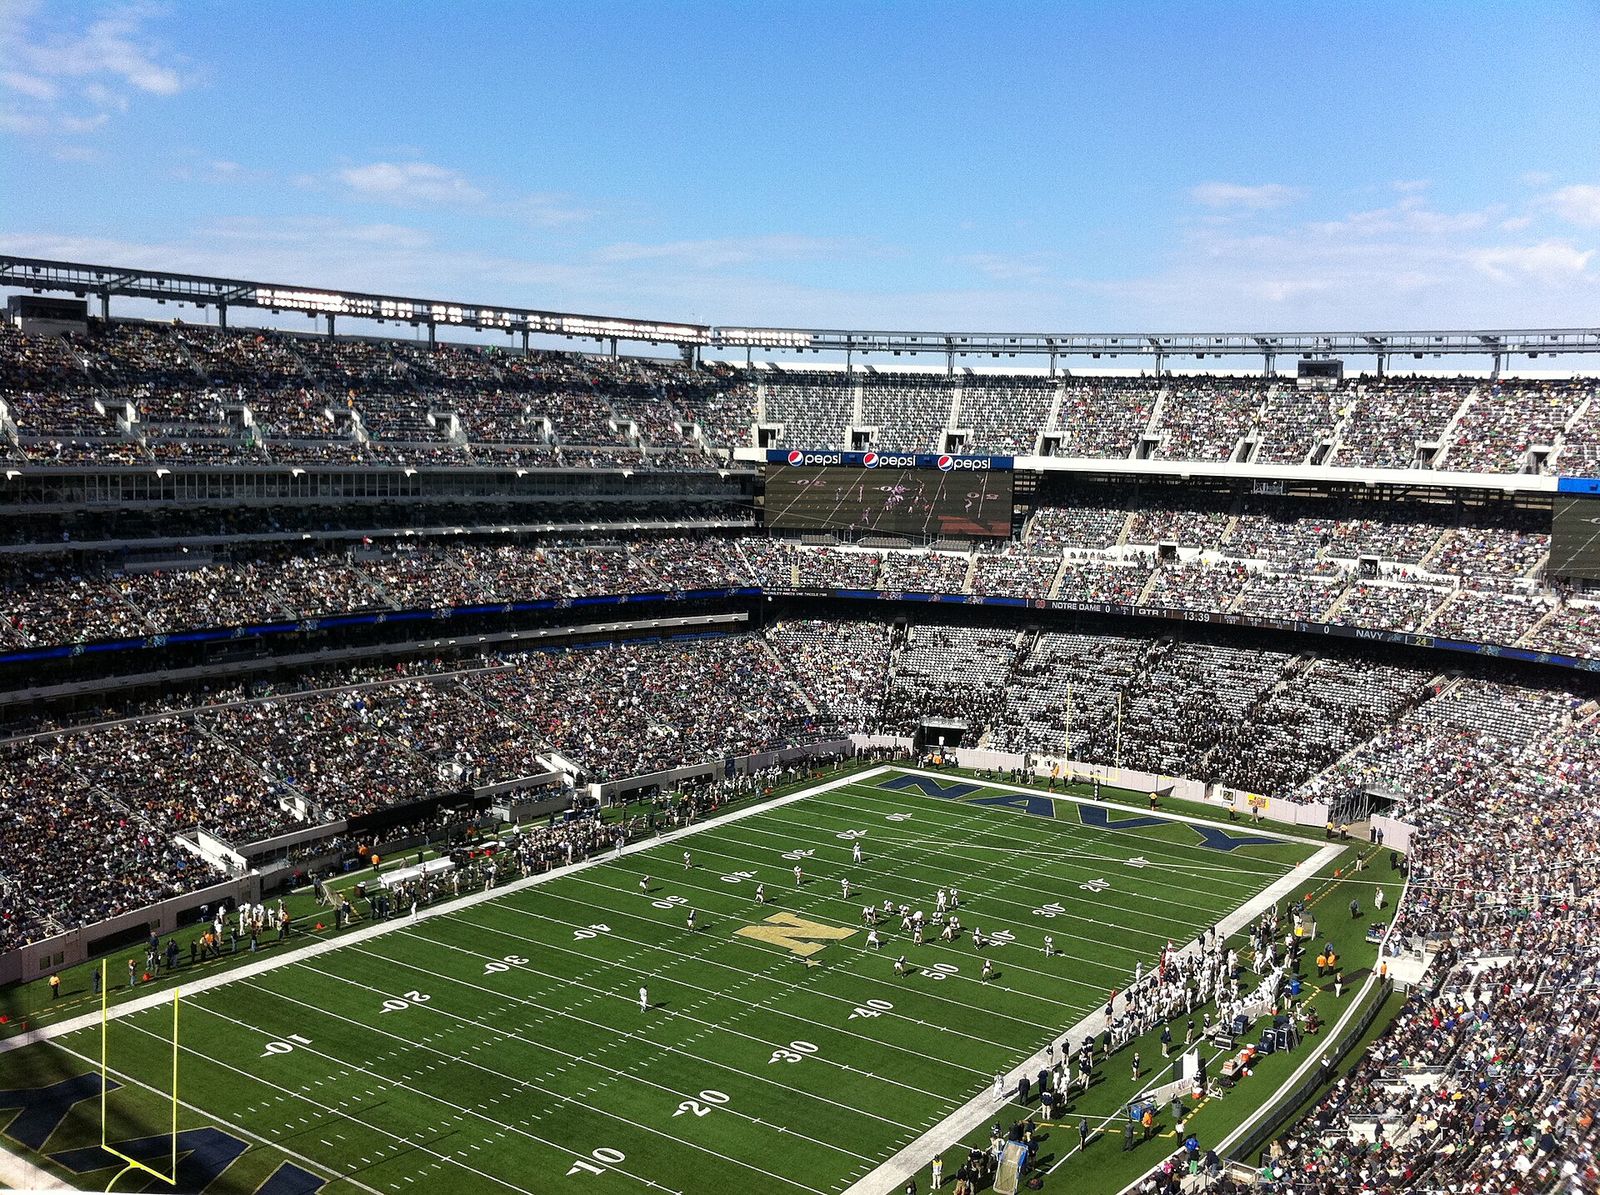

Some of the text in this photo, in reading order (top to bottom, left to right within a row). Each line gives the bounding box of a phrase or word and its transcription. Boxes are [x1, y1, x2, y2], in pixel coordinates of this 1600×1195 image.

[805, 453, 841, 466] pepsi
[879, 455, 916, 468] pepsi
[954, 457, 991, 471] pepsi
[1052, 602, 1077, 610] NOTRE
[1079, 604, 1101, 612] DAME
[1105, 605, 1111, 613] 0
[1139, 608, 1159, 616] QTR
[1183, 611, 1210, 622] 13:39
[1324, 625, 1384, 640] 0 NAVY
[1415, 637, 1427, 646] 24
[876, 774, 1298, 851] NAVY
[652, 895, 688, 909] 50
[573, 923, 611, 938] 40
[732, 911, 860, 957] N
[484, 955, 530, 973] 30
[920, 963, 959, 981] 50
[382, 990, 431, 1010] 20
[854, 999, 894, 1018] 40
[265, 1033, 313, 1053] 10
[772, 1040, 819, 1063] 30
[678, 1090, 731, 1117] 20
[573, 1147, 625, 1175] 10
